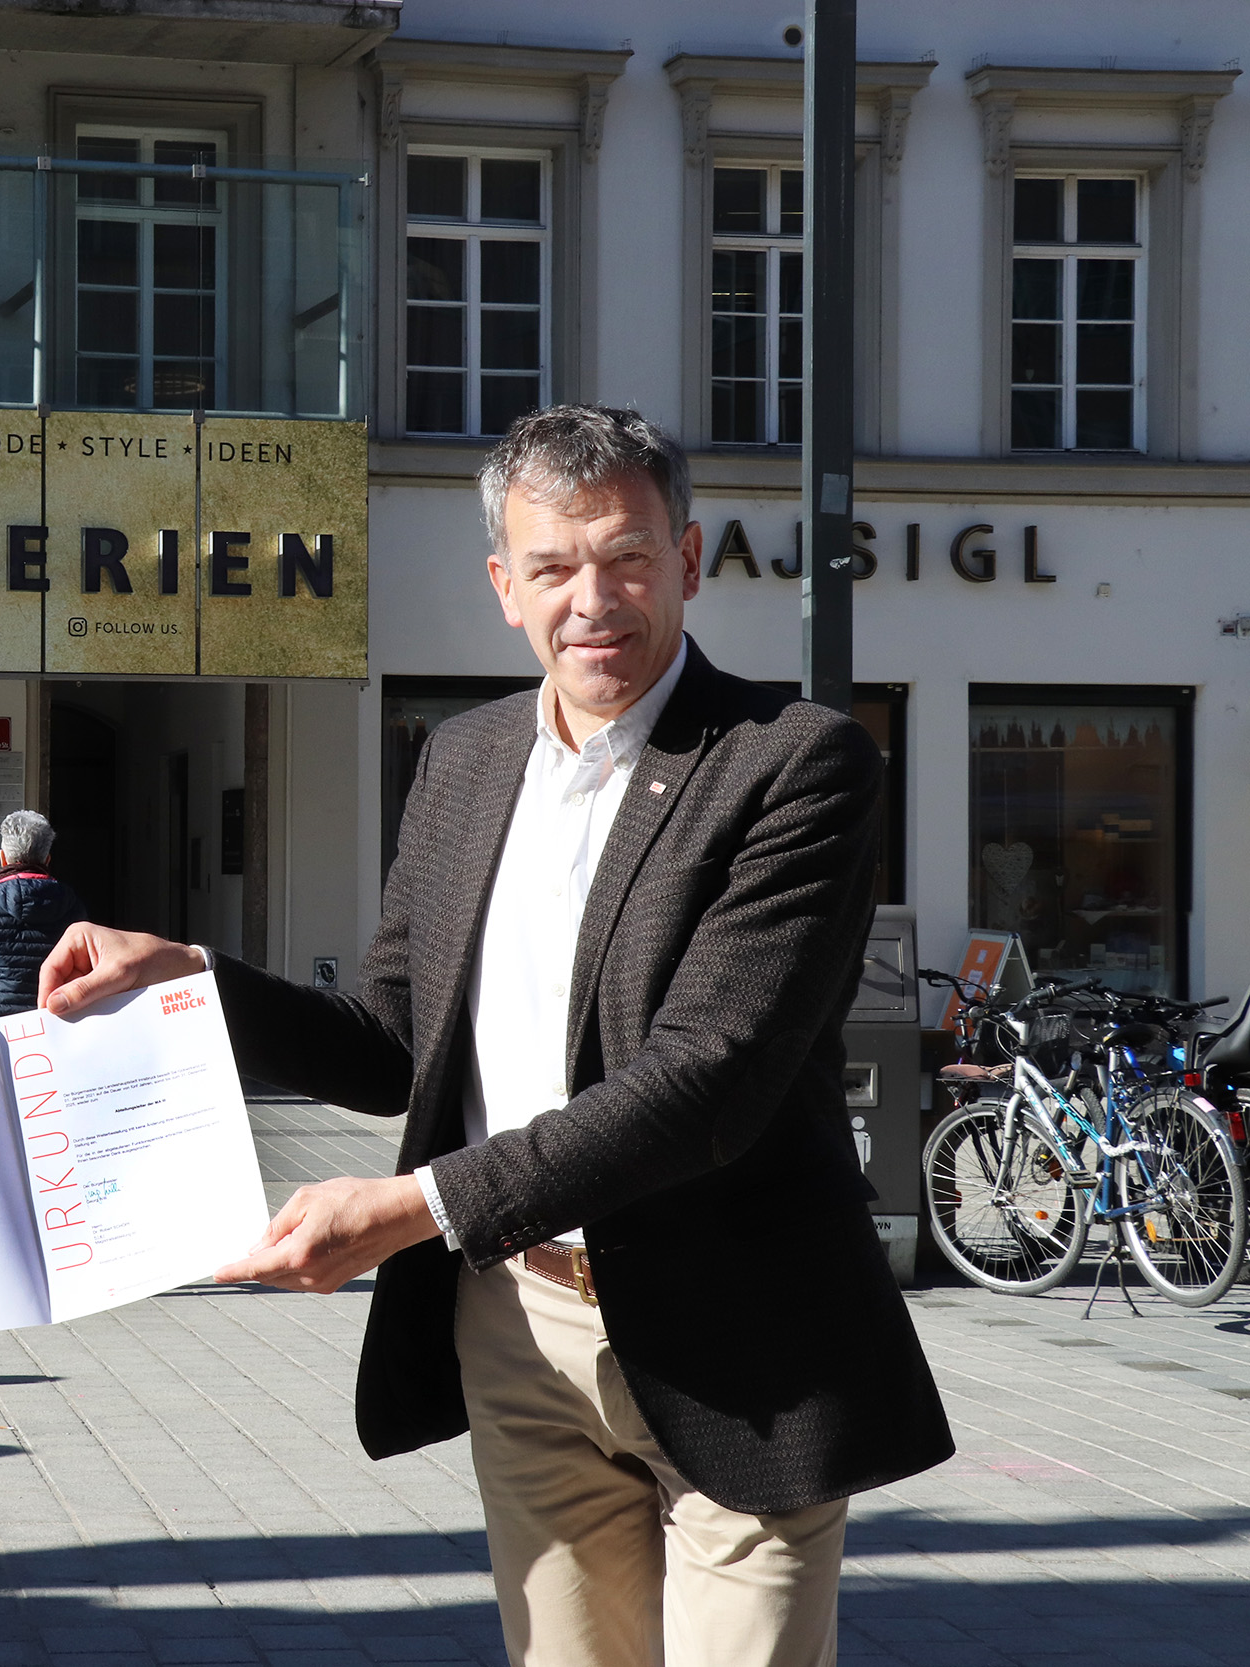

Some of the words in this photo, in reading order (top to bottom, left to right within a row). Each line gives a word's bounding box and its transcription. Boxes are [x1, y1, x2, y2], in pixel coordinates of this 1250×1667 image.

[81, 436, 168, 458] STYLE
[207, 441, 292, 464] IDEEN
[95, 622, 155, 634] FOLLOW
[160, 988, 193, 1005] INNS'
[162, 996, 206, 1015] BRUCK
[4, 1017, 93, 1271] URKUNDE
